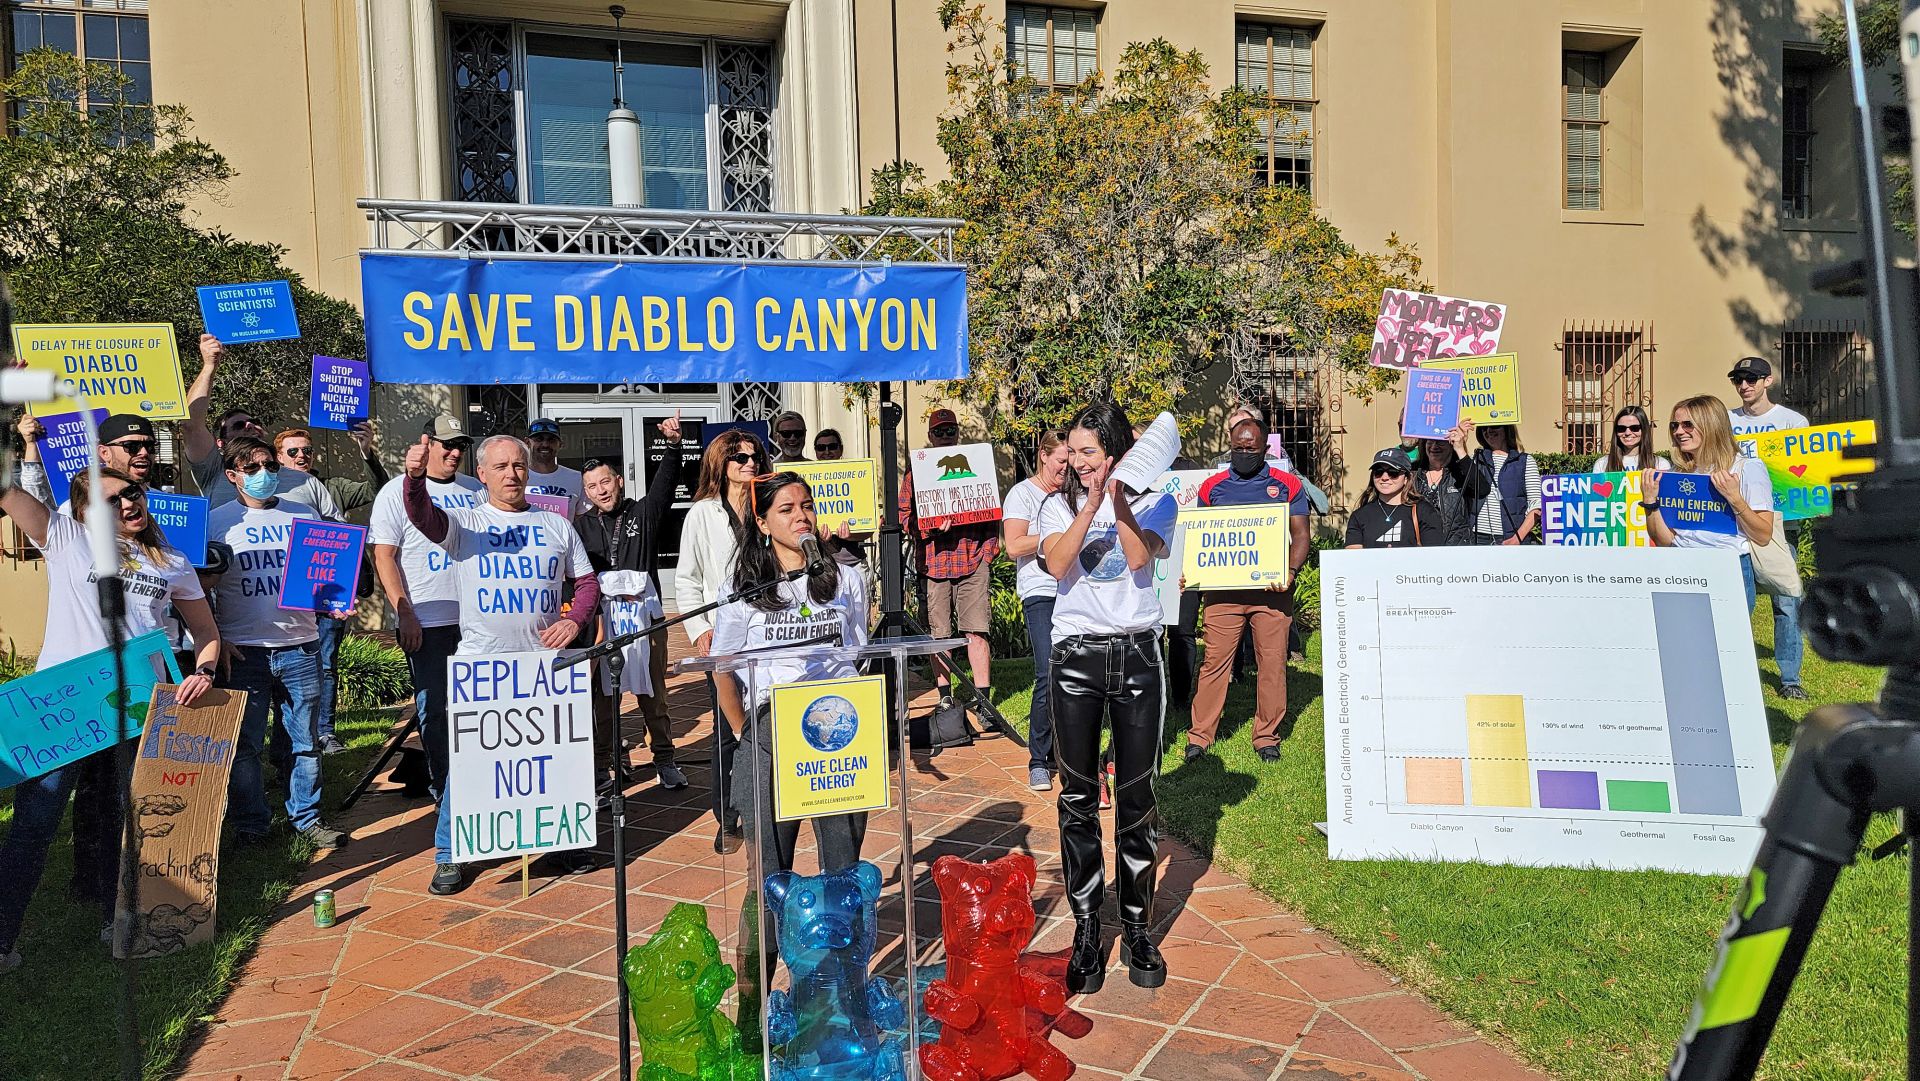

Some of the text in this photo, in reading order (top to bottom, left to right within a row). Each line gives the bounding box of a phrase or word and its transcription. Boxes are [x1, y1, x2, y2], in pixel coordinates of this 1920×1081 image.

[215, 287, 275, 300] LISTEN TO THE
[218, 298, 277, 312] SCIENTISTS!
[1380, 289, 1503, 338] MOTHERS
[402, 291, 938, 352] SAVE DIABLO CANYON
[32, 338, 162, 351] DELAY THE CLOSURE OF
[64, 354, 138, 374] DIABLO
[331, 366, 353, 376] STOP
[1466, 366, 1497, 375] CLOSURE
[1499, 364, 1509, 373] OF
[320, 374, 363, 387] SHUTTING
[1462, 377, 1491, 391] ABLO
[328, 384, 354, 395] DOWN
[1424, 391, 1444, 402] ACT
[321, 393, 360, 405] NUCLEAR
[1461, 393, 1496, 408] NYON
[323, 403, 356, 414] PLANTS
[1421, 403, 1443, 415] LIKE
[330, 413, 348, 423] FFS!
[1425, 415, 1436, 426] IT
[58, 420, 87, 435] STOP
[47, 433, 90, 449] SHUTTI
[1784, 429, 1856, 456] Plant
[809, 473, 822, 481] THE
[824, 471, 856, 480] CLOSURE
[858, 470, 867, 479] OF
[813, 482, 850, 498] IABLO
[916, 483, 993, 504] HISTORY HAS ITS EYES
[1541, 475, 1642, 497] CLEAN AI
[153, 499, 167, 510] TO
[169, 500, 189, 511] THE
[813, 499, 854, 515] ANYON
[918, 496, 997, 517] ON CALIFORNIA
[1657, 497, 1727, 512] LEAN ENERGY
[150, 512, 188, 527] TISTS!
[921, 518, 937, 529] SAVE
[968, 510, 994, 522] CANYON
[1209, 519, 1225, 528] THE
[1226, 517, 1265, 527] CLOSURE
[1266, 516, 1278, 526] OF
[1545, 501, 1648, 530] ENERG
[1677, 510, 1705, 523] NOW!
[308, 527, 327, 538] THIS
[327, 530, 337, 539] IS
[488, 524, 547, 547] SAVE
[1201, 530, 1256, 548] DIABLO
[1545, 530, 1651, 547] EQUALIT
[303, 537, 351, 550] EMERGENCY
[238, 550, 286, 571] DIAB
[311, 550, 338, 566] ACT
[1197, 550, 1259, 568] CANYON
[307, 566, 337, 582] LIKE
[479, 554, 559, 580] DIABLO
[240, 576, 280, 597] CAN
[1395, 573, 1708, 588] Shutting down Diablo Canyon is the same as closing
[312, 582, 327, 596] IT
[477, 587, 558, 614] CANYON
[764, 612, 807, 625] NUCLEAR
[765, 621, 842, 640] IS CLEAN ENERGY
[452, 657, 587, 703] REPLACE
[0, 667, 113, 718] There is
[1335, 576, 1353, 825] Annual California Electricity Generation (TWh)
[40, 707, 76, 732] no
[453, 703, 589, 753] FOSSIL
[1625, 725, 1663, 733] geothermal
[796, 756, 868, 777] SAVE CLEAN
[161, 771, 200, 788] NOT
[495, 755, 553, 799] NOT
[810, 773, 857, 792] ENERGY
[455, 802, 592, 857] NUCLEAR
[1410, 823, 1464, 832] Diablo Canyon
[1494, 825, 1514, 833] Solar
[1563, 828, 1583, 836] Wind
[1620, 830, 1666, 840] Geothermal
[1693, 833, 1735, 843] Fossil Gas
